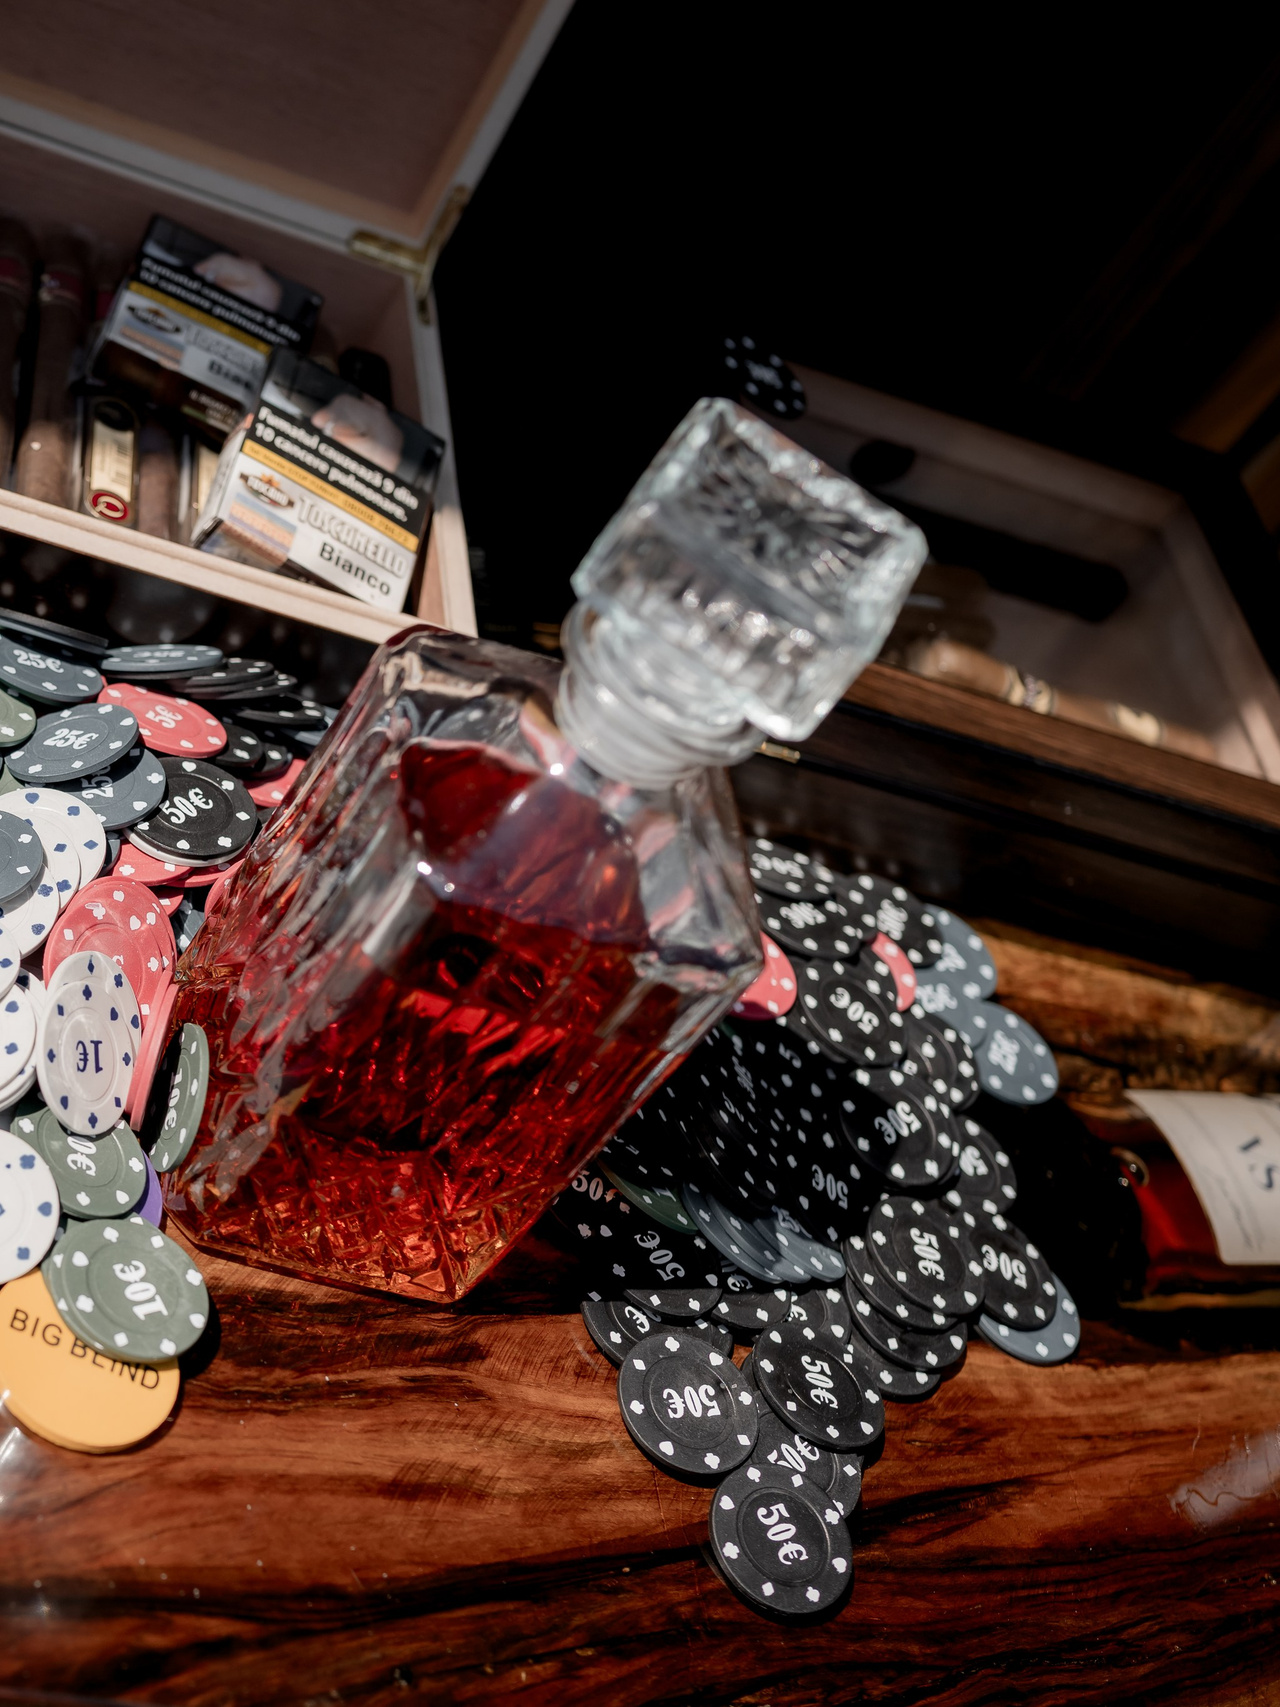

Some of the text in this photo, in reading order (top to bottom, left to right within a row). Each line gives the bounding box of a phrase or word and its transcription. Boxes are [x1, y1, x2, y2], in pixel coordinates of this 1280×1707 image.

[255, 423, 408, 523] 10 cancere pulmonare.
[258, 406, 320, 450] Fumatul
[382, 478, 396, 495] 9
[393, 484, 419, 511] din
[320, 541, 391, 597] Bianco
[13, 649, 65, 675] 25€
[43, 727, 100, 751] 25€
[145, 705, 184, 729] 5€
[159, 787, 214, 825] 50€
[829, 986, 880, 1035] 50€
[75, 1039, 104, 1075] 1€
[873, 1100, 922, 1146] 50€
[811, 1163, 849, 1211] 50€
[634, 1230, 686, 1282] 50€
[909, 1227, 946, 1283] 50€
[981, 1243, 1028, 1290] 50€
[112, 1259, 169, 1322] 10€
[10, 1308, 63, 1349] BIG
[662, 1384, 722, 1420] 50€
[800, 1355, 839, 1410] 50€
[756, 1502, 809, 1566] 50€
